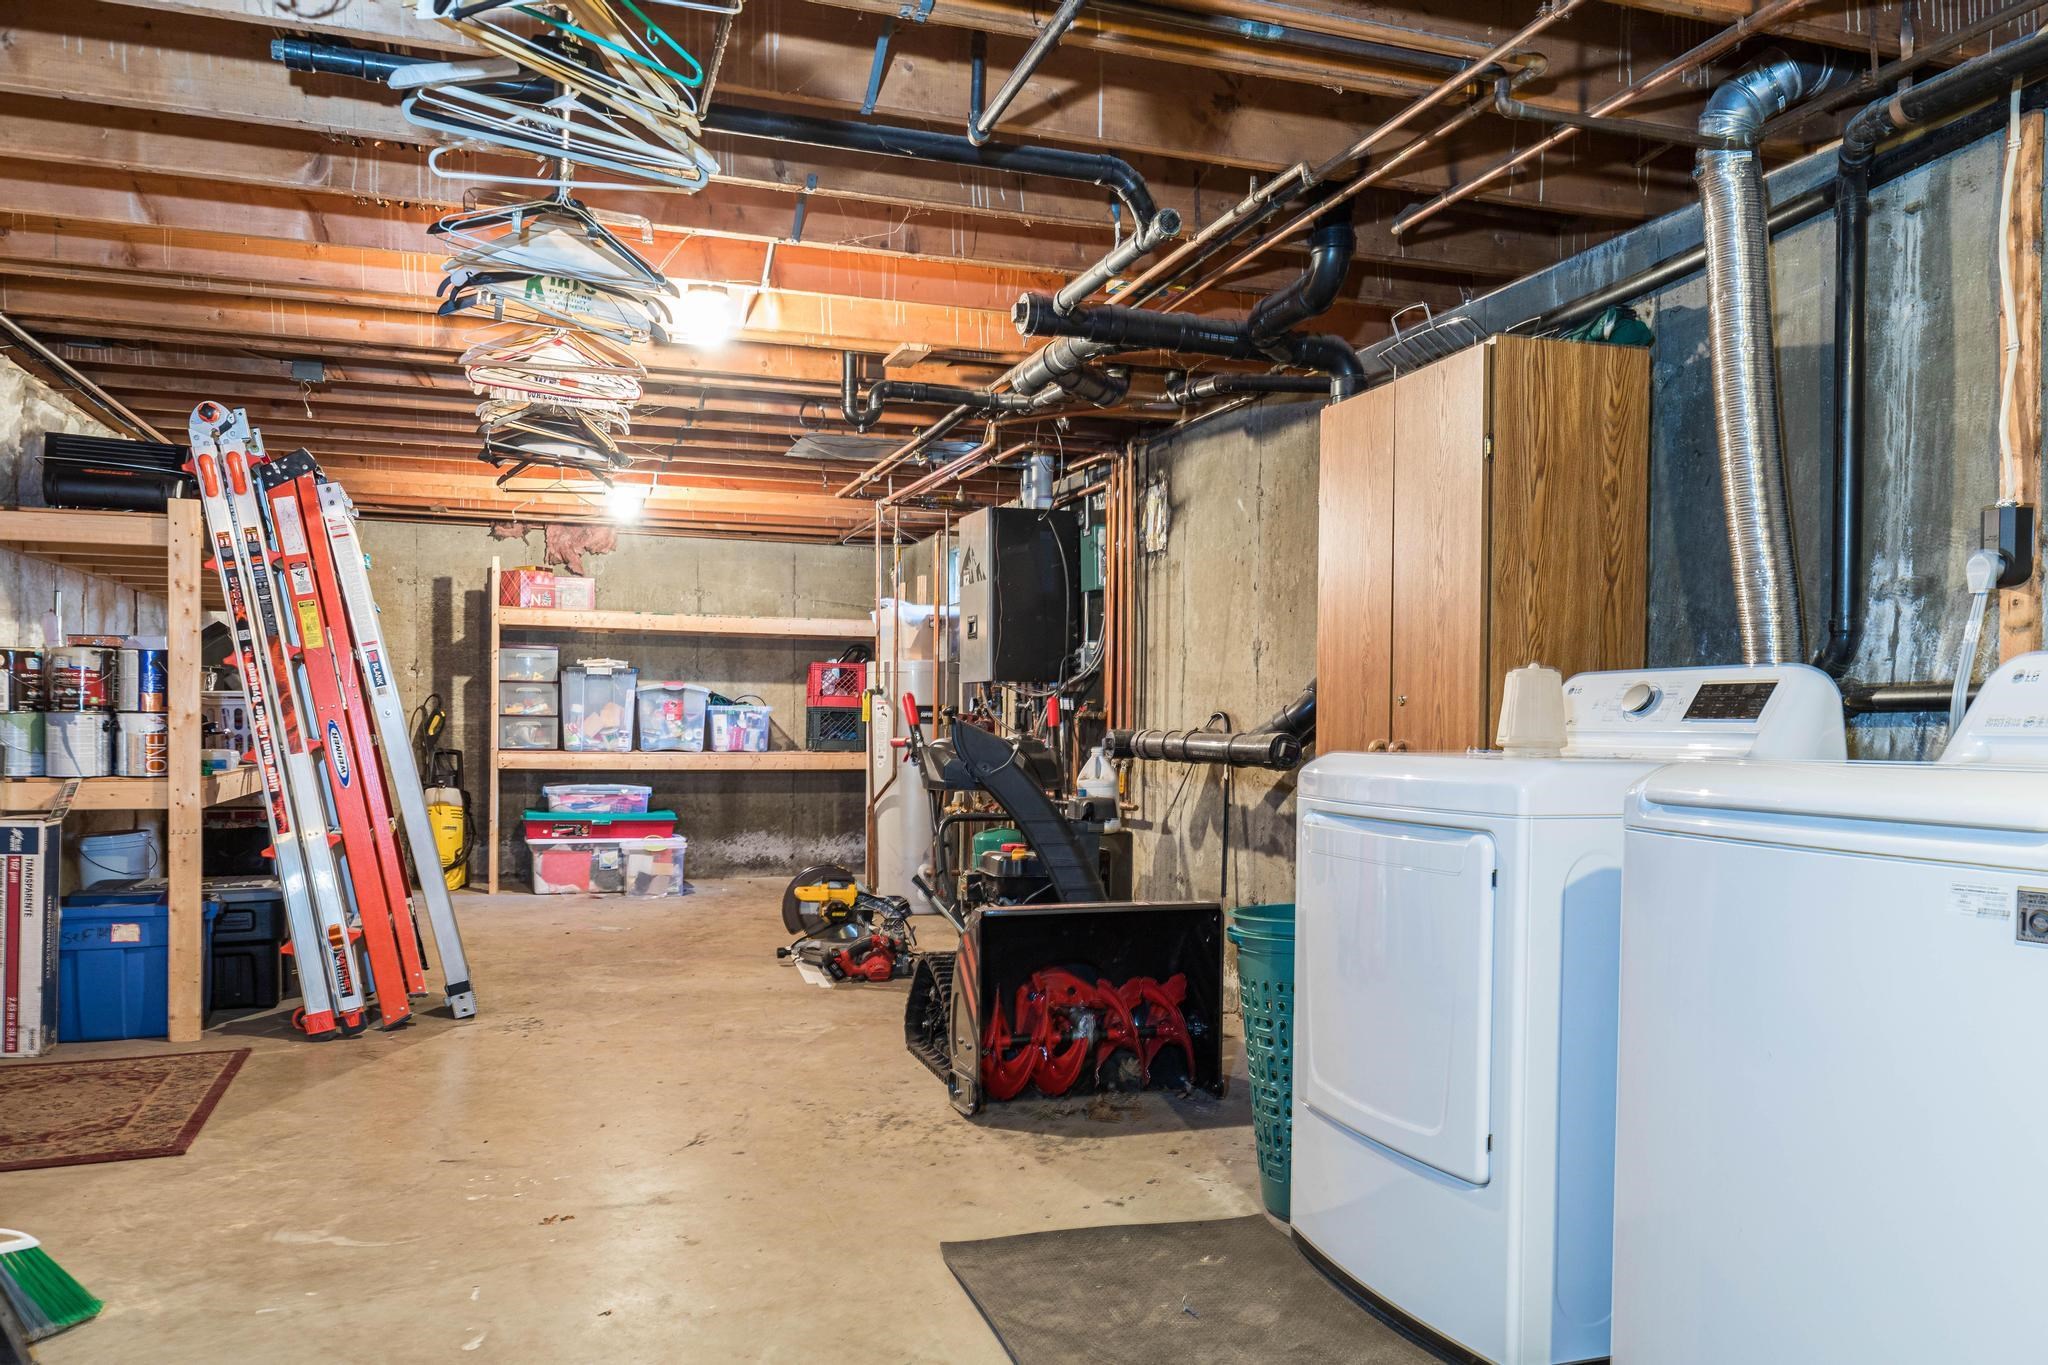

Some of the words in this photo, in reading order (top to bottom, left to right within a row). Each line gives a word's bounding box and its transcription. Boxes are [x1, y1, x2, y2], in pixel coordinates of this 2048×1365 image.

[247, 662, 261, 702] Systems
[372, 662, 384, 685] PLANK
[255, 705, 268, 738] Ladder
[146, 733, 167, 773] ONE
[261, 740, 274, 764] Giant
[332, 732, 347, 773] WERNER
[267, 767, 279, 792] Little
[24, 858, 34, 918] TRANSPARENTE
